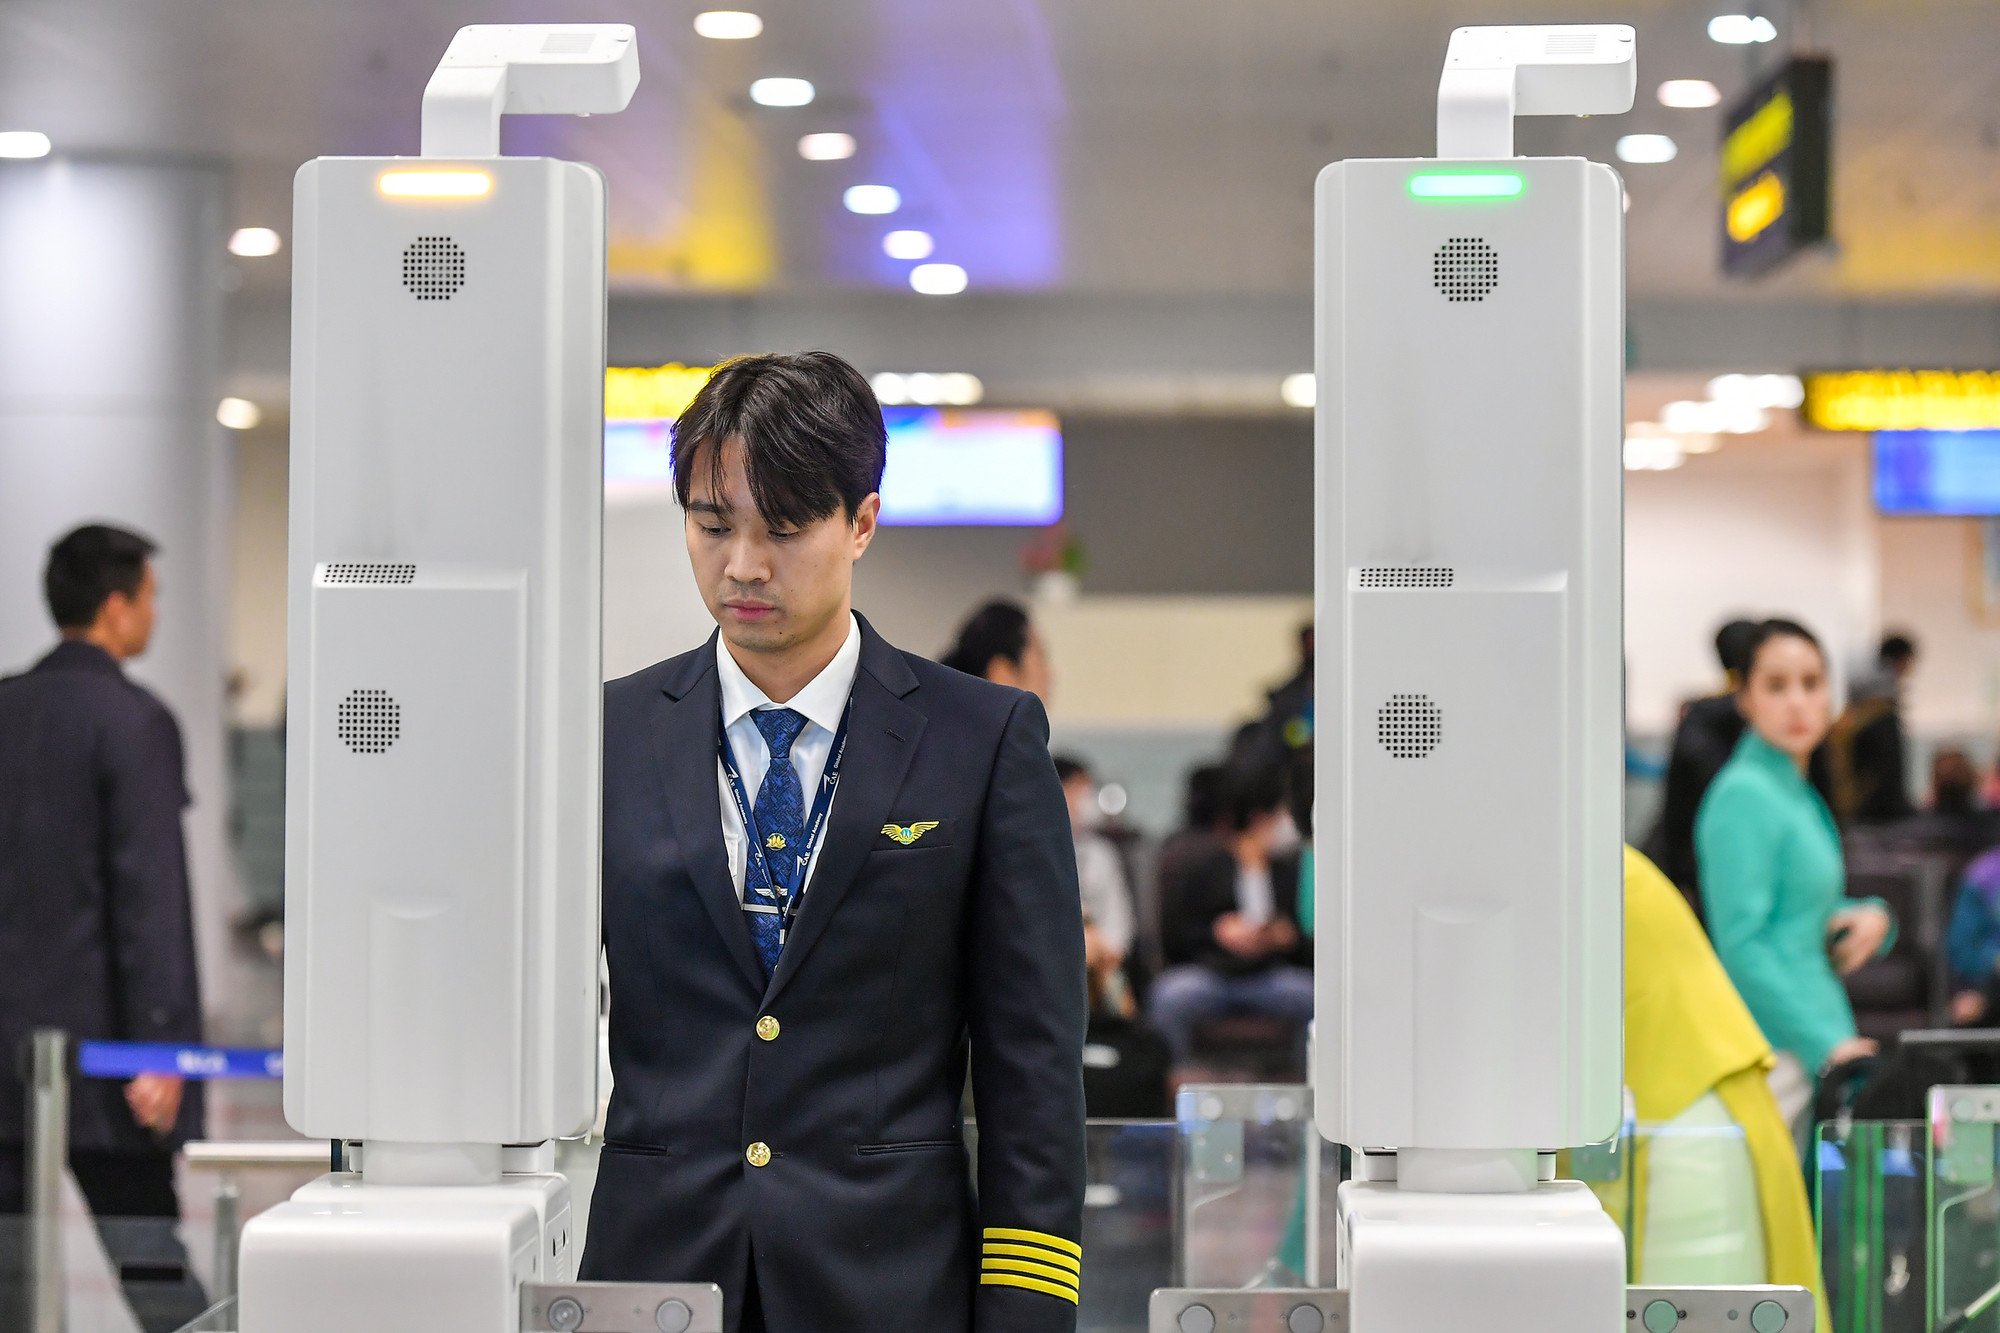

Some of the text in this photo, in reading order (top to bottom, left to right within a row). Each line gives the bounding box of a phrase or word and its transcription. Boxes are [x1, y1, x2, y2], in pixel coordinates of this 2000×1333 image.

[833, 753, 842, 769] Global
[734, 788, 742, 804] Global
[739, 803, 748, 825] Academy
[801, 812, 824, 866] CAE Global Academy
